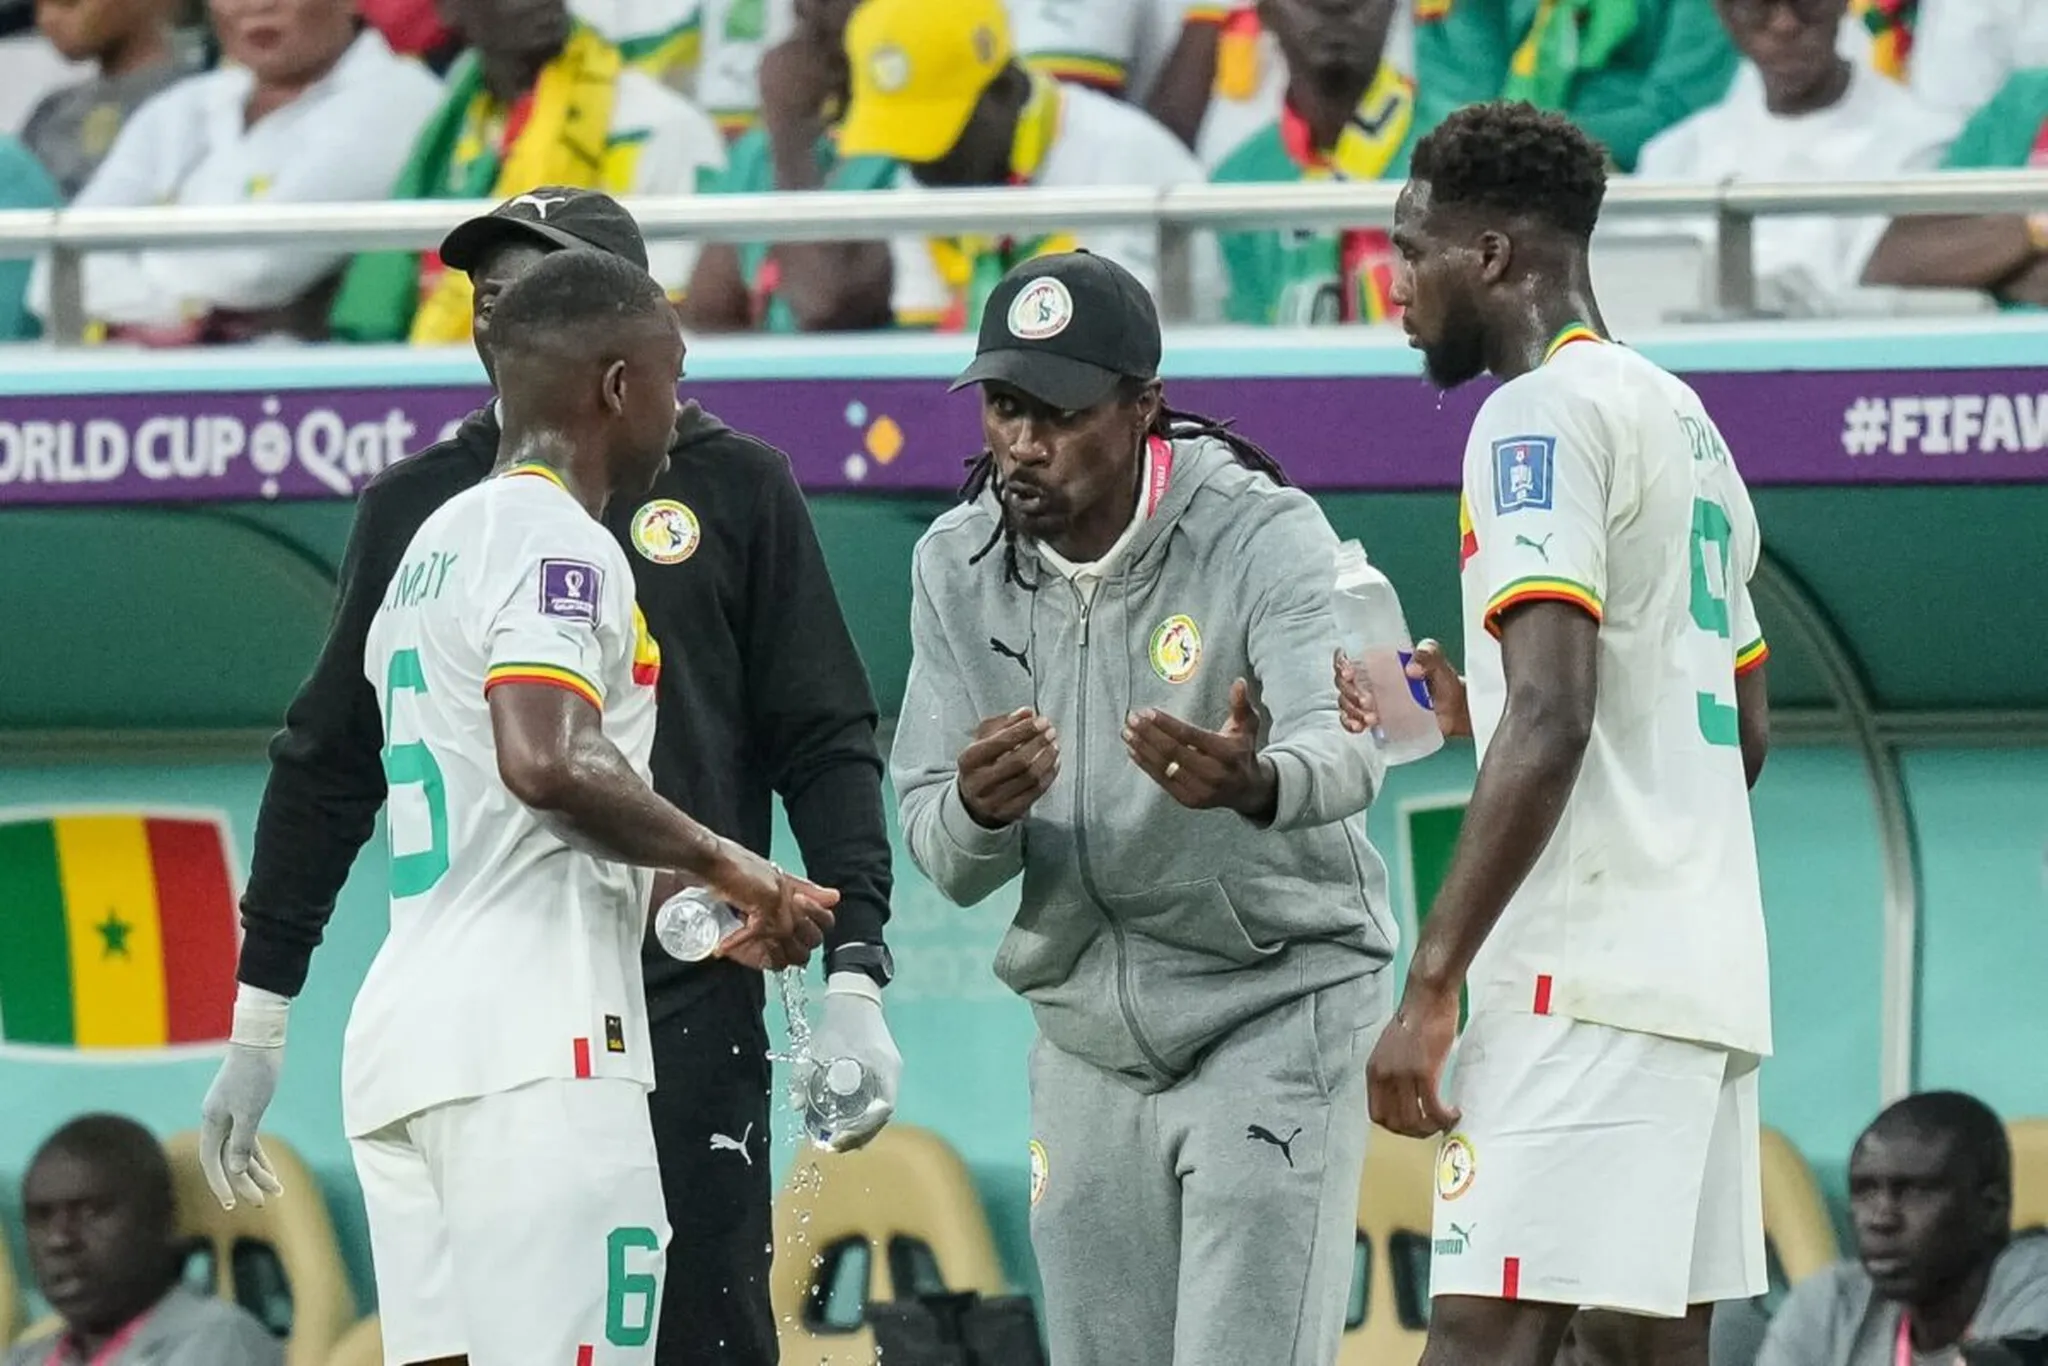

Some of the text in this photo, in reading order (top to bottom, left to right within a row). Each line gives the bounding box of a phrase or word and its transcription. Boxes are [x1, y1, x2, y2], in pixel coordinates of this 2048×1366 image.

[133, 416, 245, 480] CUP
[298, 408, 462, 496] Qat
[1688, 496, 1738, 746] 9
[380, 648, 450, 899] 6
[605, 1226, 660, 1347] 6
